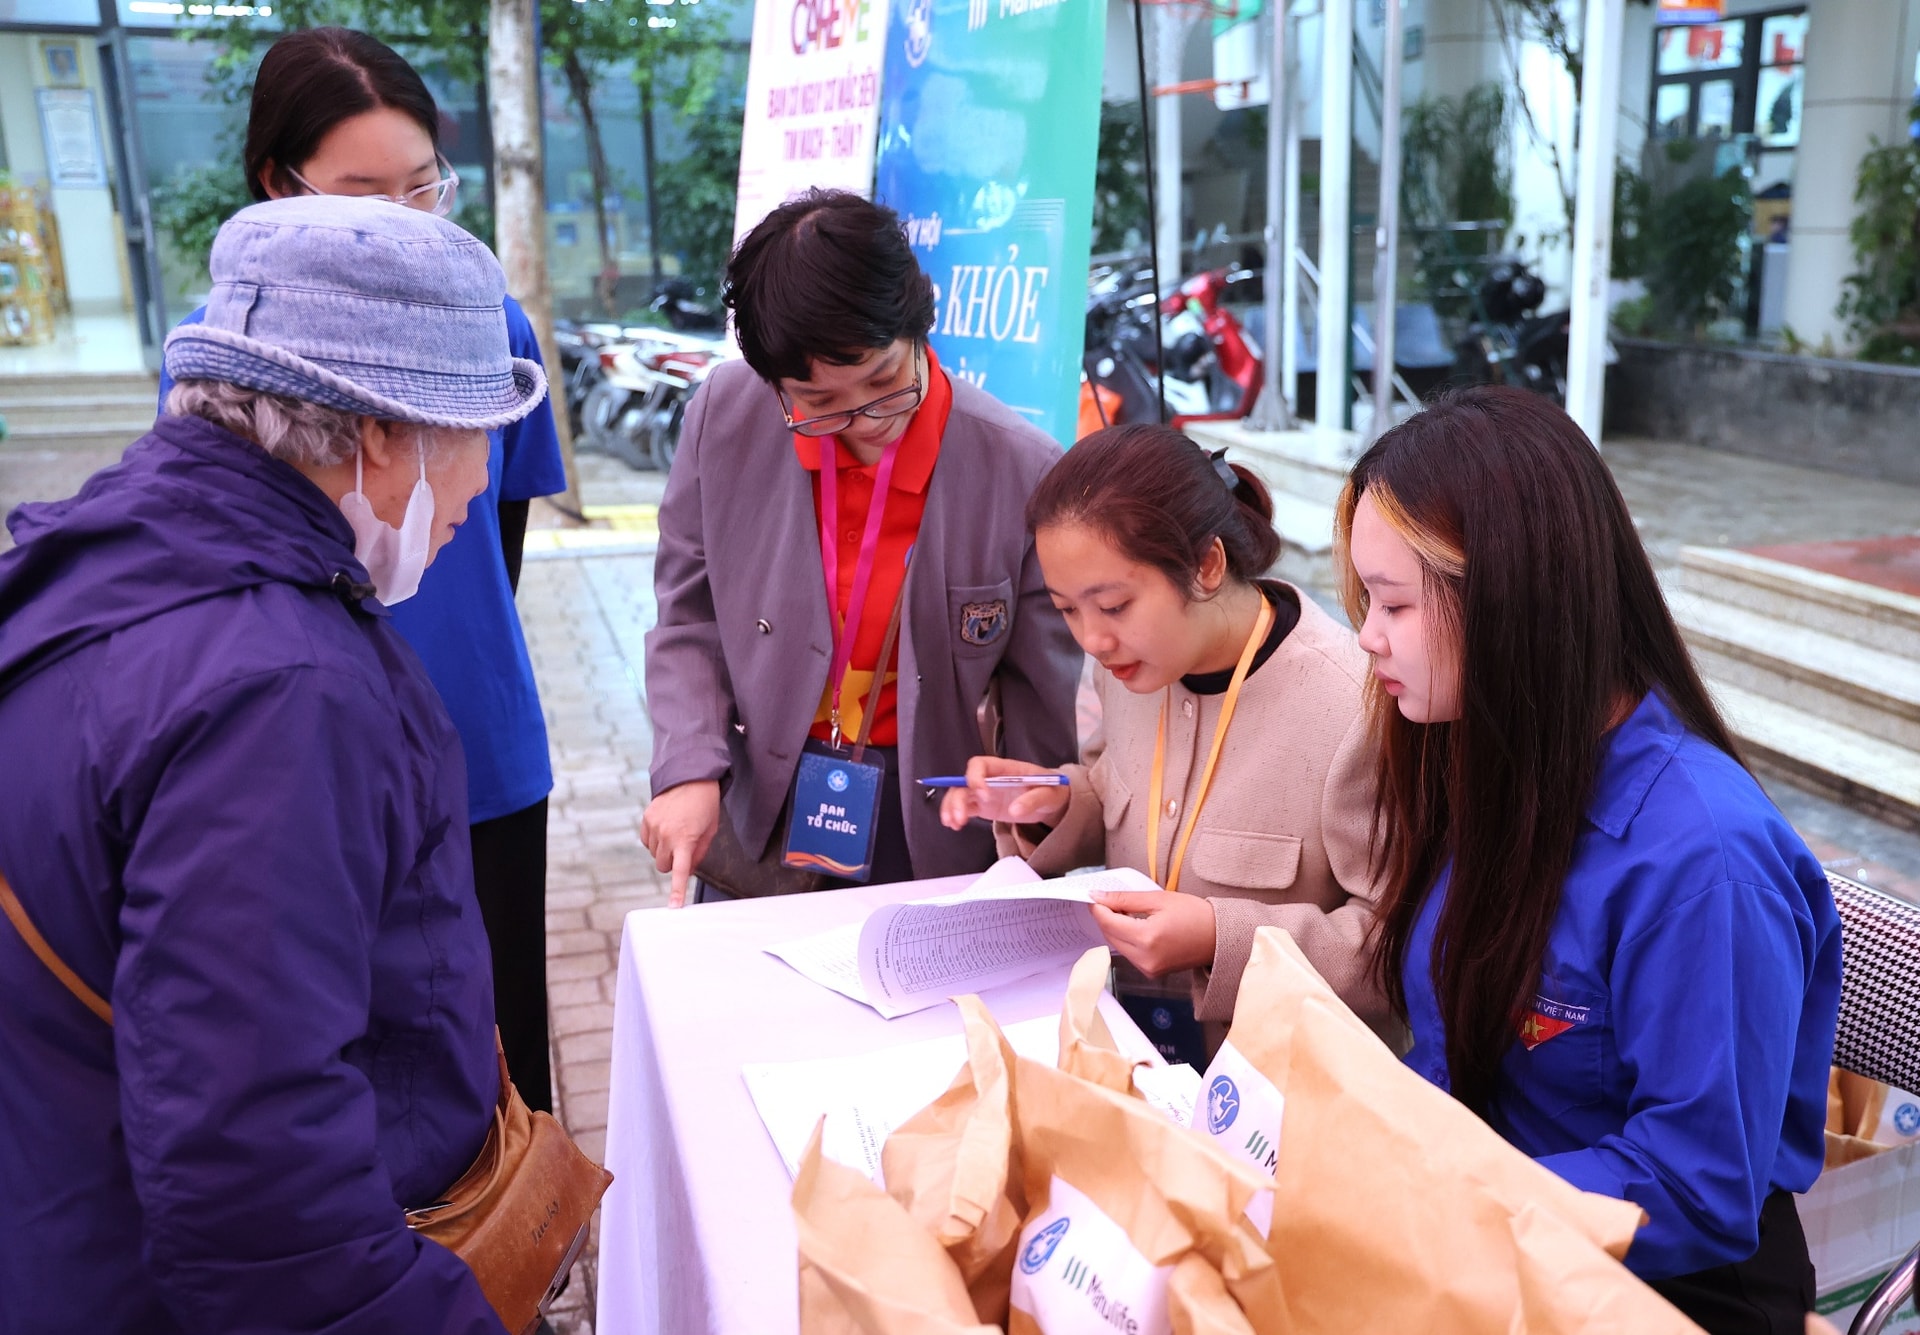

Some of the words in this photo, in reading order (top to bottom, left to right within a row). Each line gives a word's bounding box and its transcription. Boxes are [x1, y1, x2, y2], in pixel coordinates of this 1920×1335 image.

[941, 243, 1049, 344] KHỎE
[820, 803, 845, 817] BAN
[806, 812, 823, 828] TỔ
[825, 820, 858, 835] CHỨC
[1564, 1010, 1586, 1022] NAM
